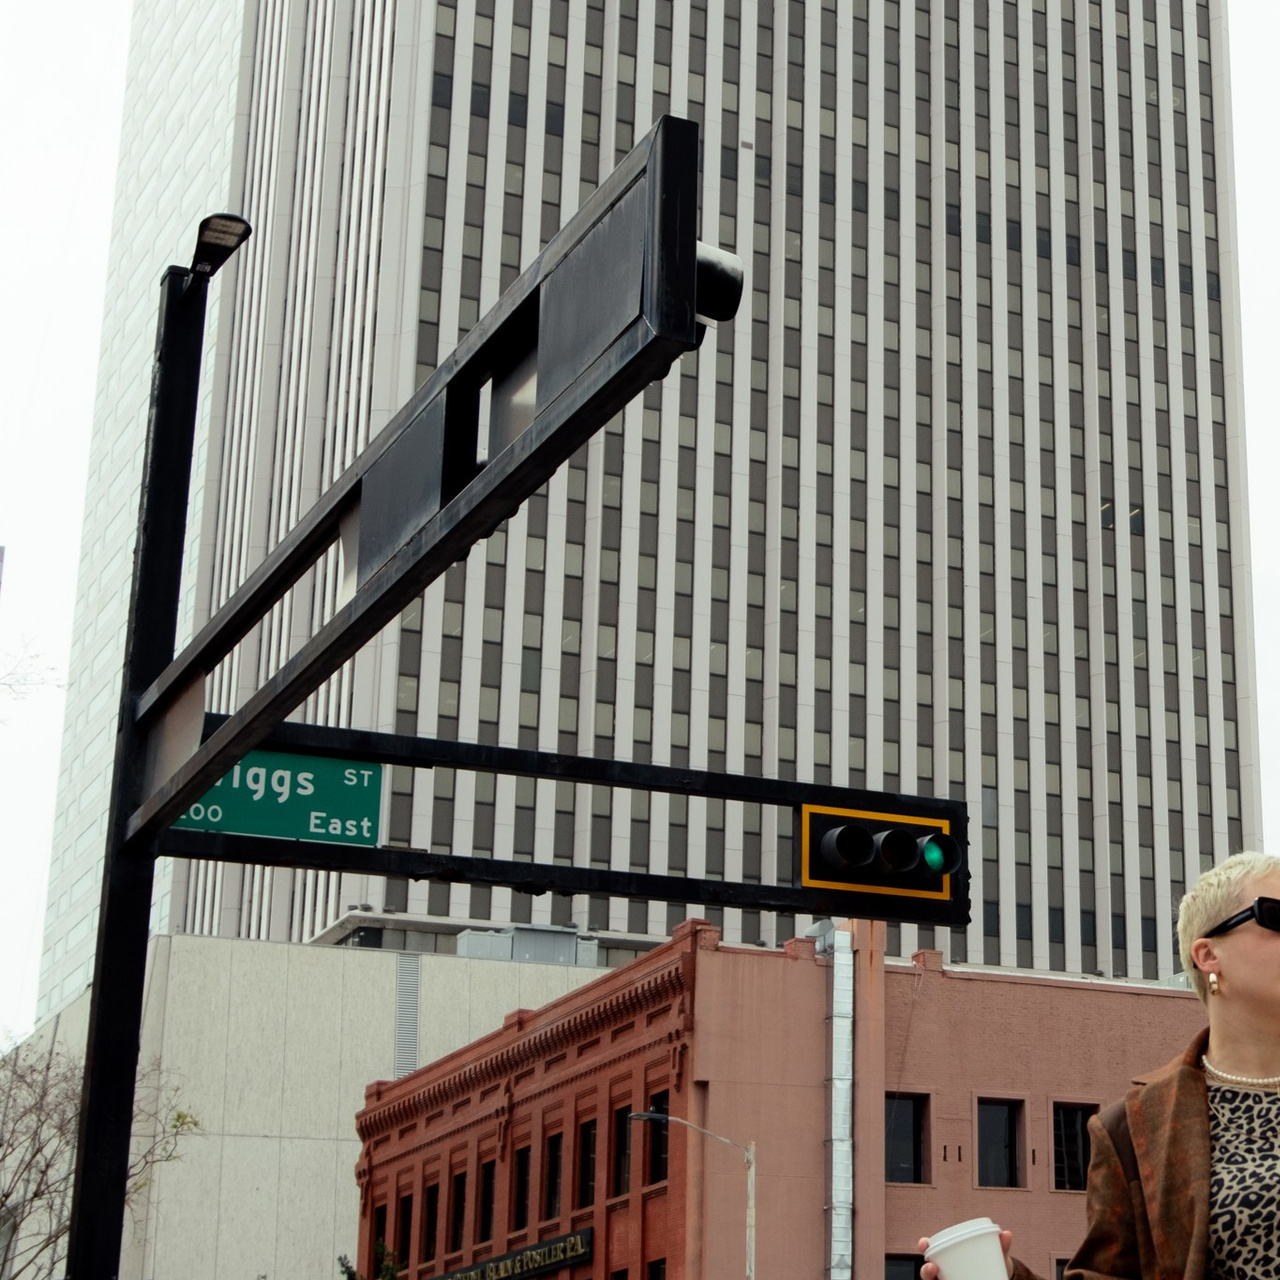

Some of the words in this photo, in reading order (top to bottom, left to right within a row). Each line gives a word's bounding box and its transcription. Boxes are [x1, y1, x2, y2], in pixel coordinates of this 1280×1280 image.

[214, 761, 315, 803] iggs
[343, 768, 373, 787] ST
[179, 802, 223, 822] 00
[309, 811, 372, 838] East
